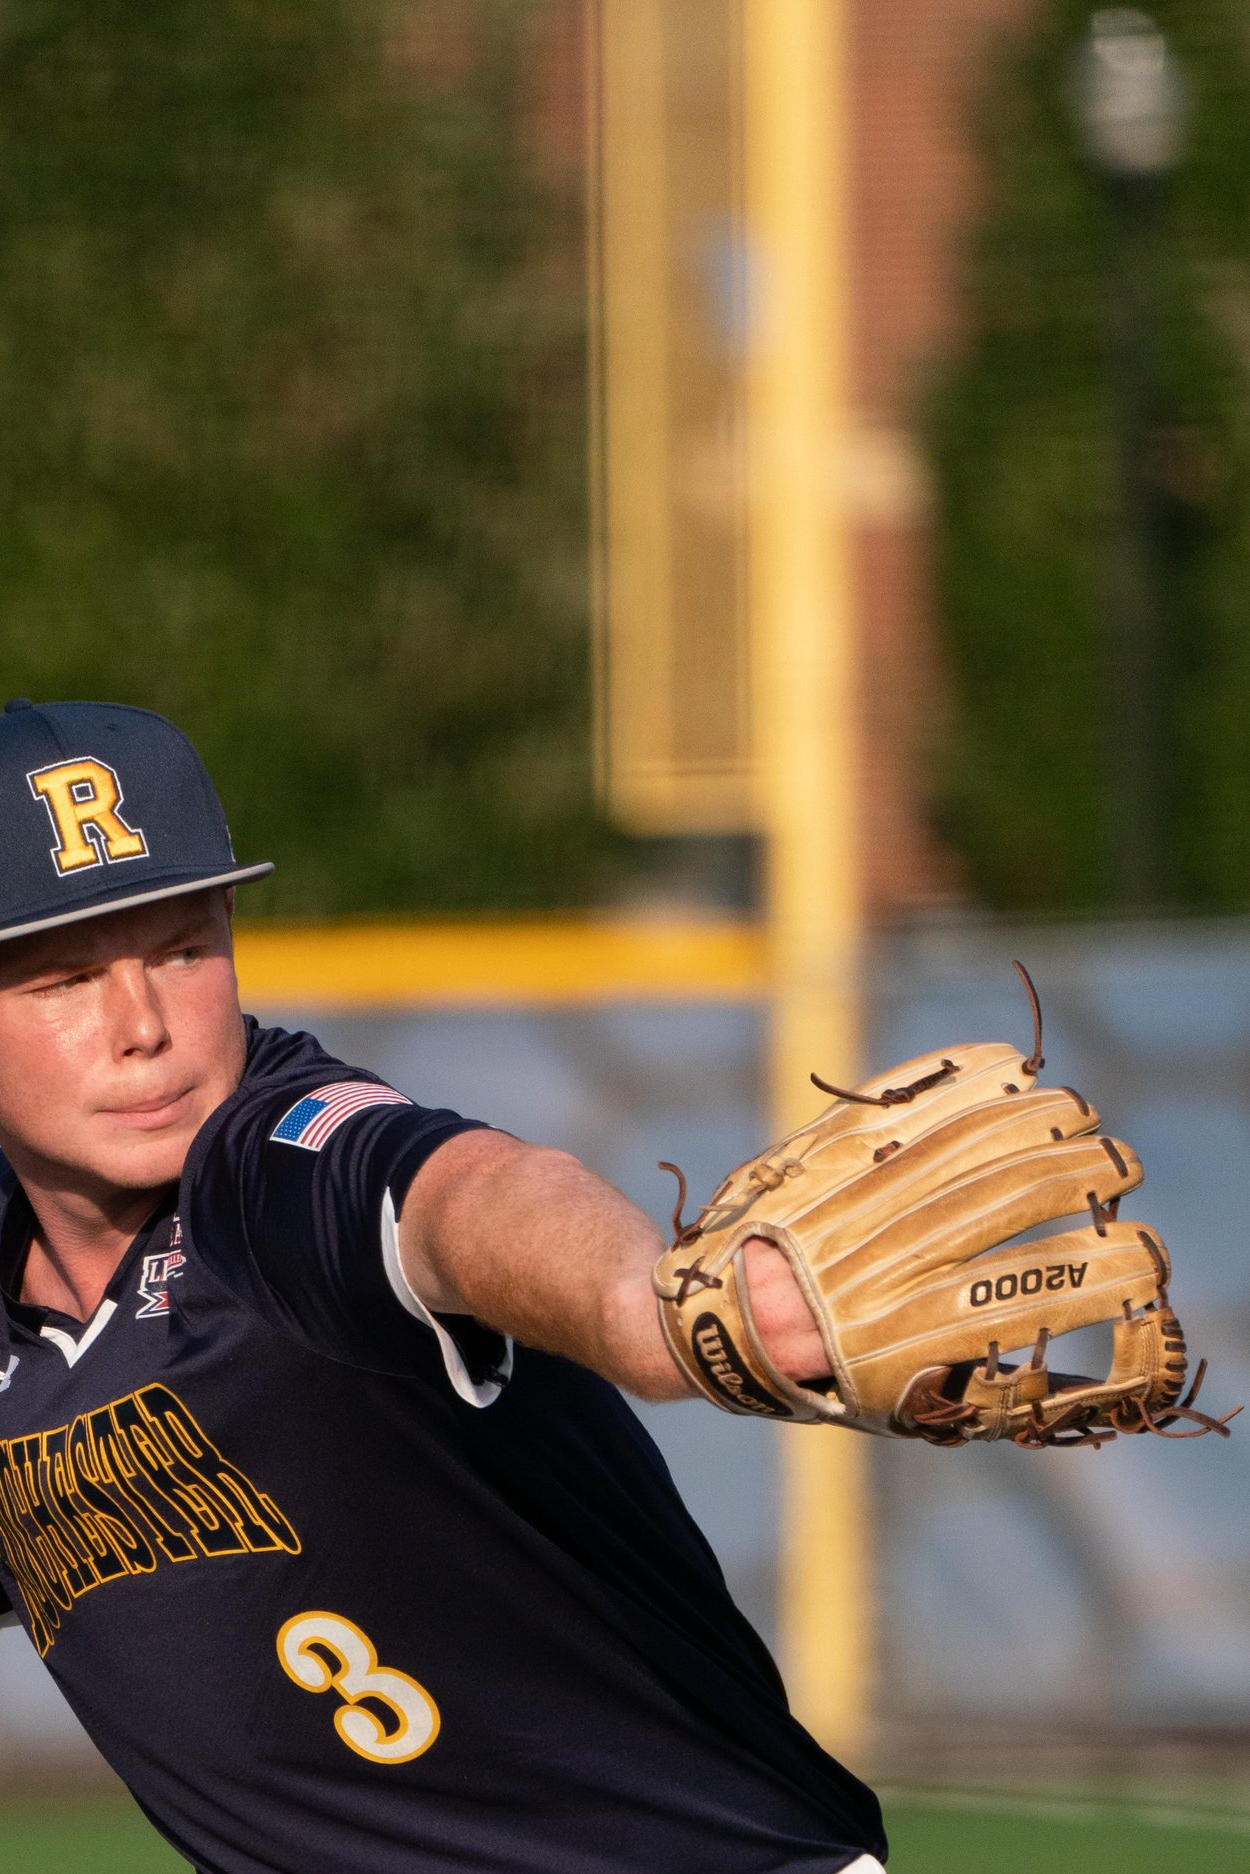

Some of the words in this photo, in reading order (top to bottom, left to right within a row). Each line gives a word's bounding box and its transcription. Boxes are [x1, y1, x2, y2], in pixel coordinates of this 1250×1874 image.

[27, 757, 149, 877] R
[970, 1262, 1088, 1307] A2000
[696, 1323, 780, 1414] Wilson
[277, 1611, 440, 1765] 3
